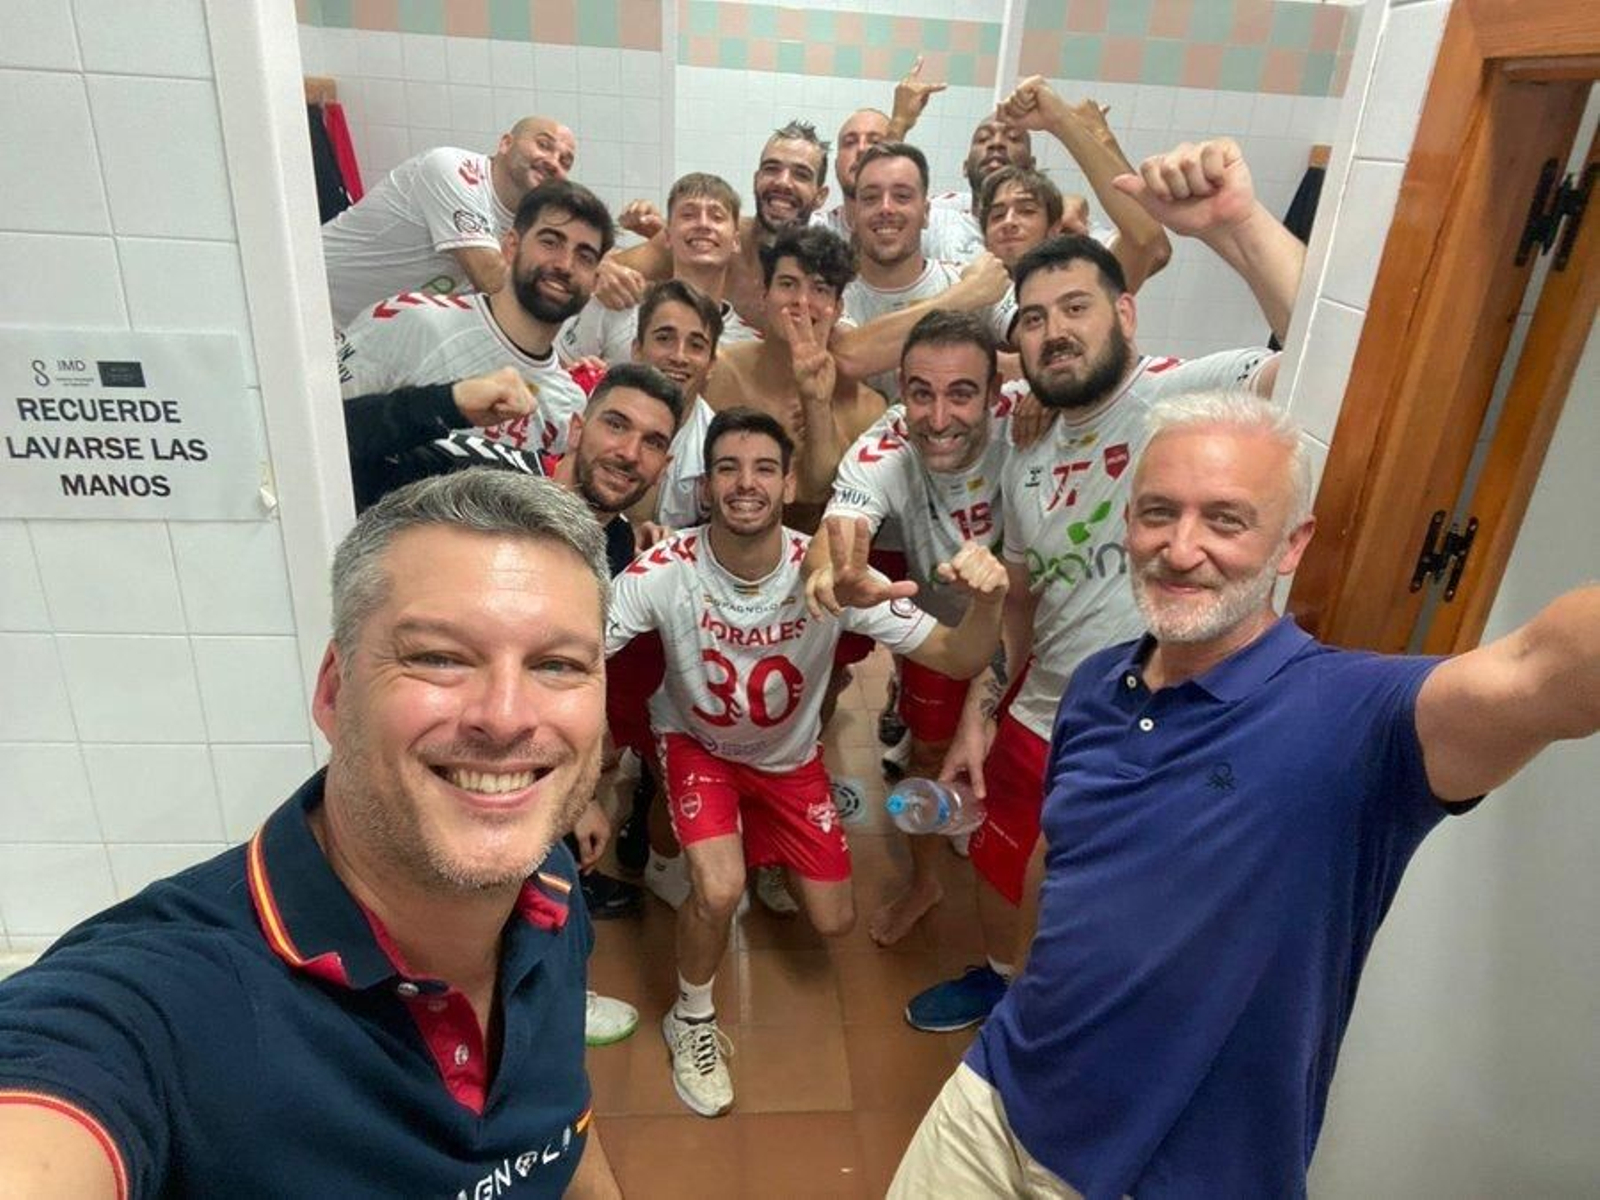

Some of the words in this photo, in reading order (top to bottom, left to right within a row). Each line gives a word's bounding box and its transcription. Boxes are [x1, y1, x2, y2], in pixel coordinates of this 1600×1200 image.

[17, 398, 182, 423] RECUERDE
[6, 436, 144, 460] LAVARSE
[150, 438, 209, 461] LAS
[60, 474, 171, 496] MANOS
[950, 502, 994, 541] 15
[692, 648, 804, 728] 30
